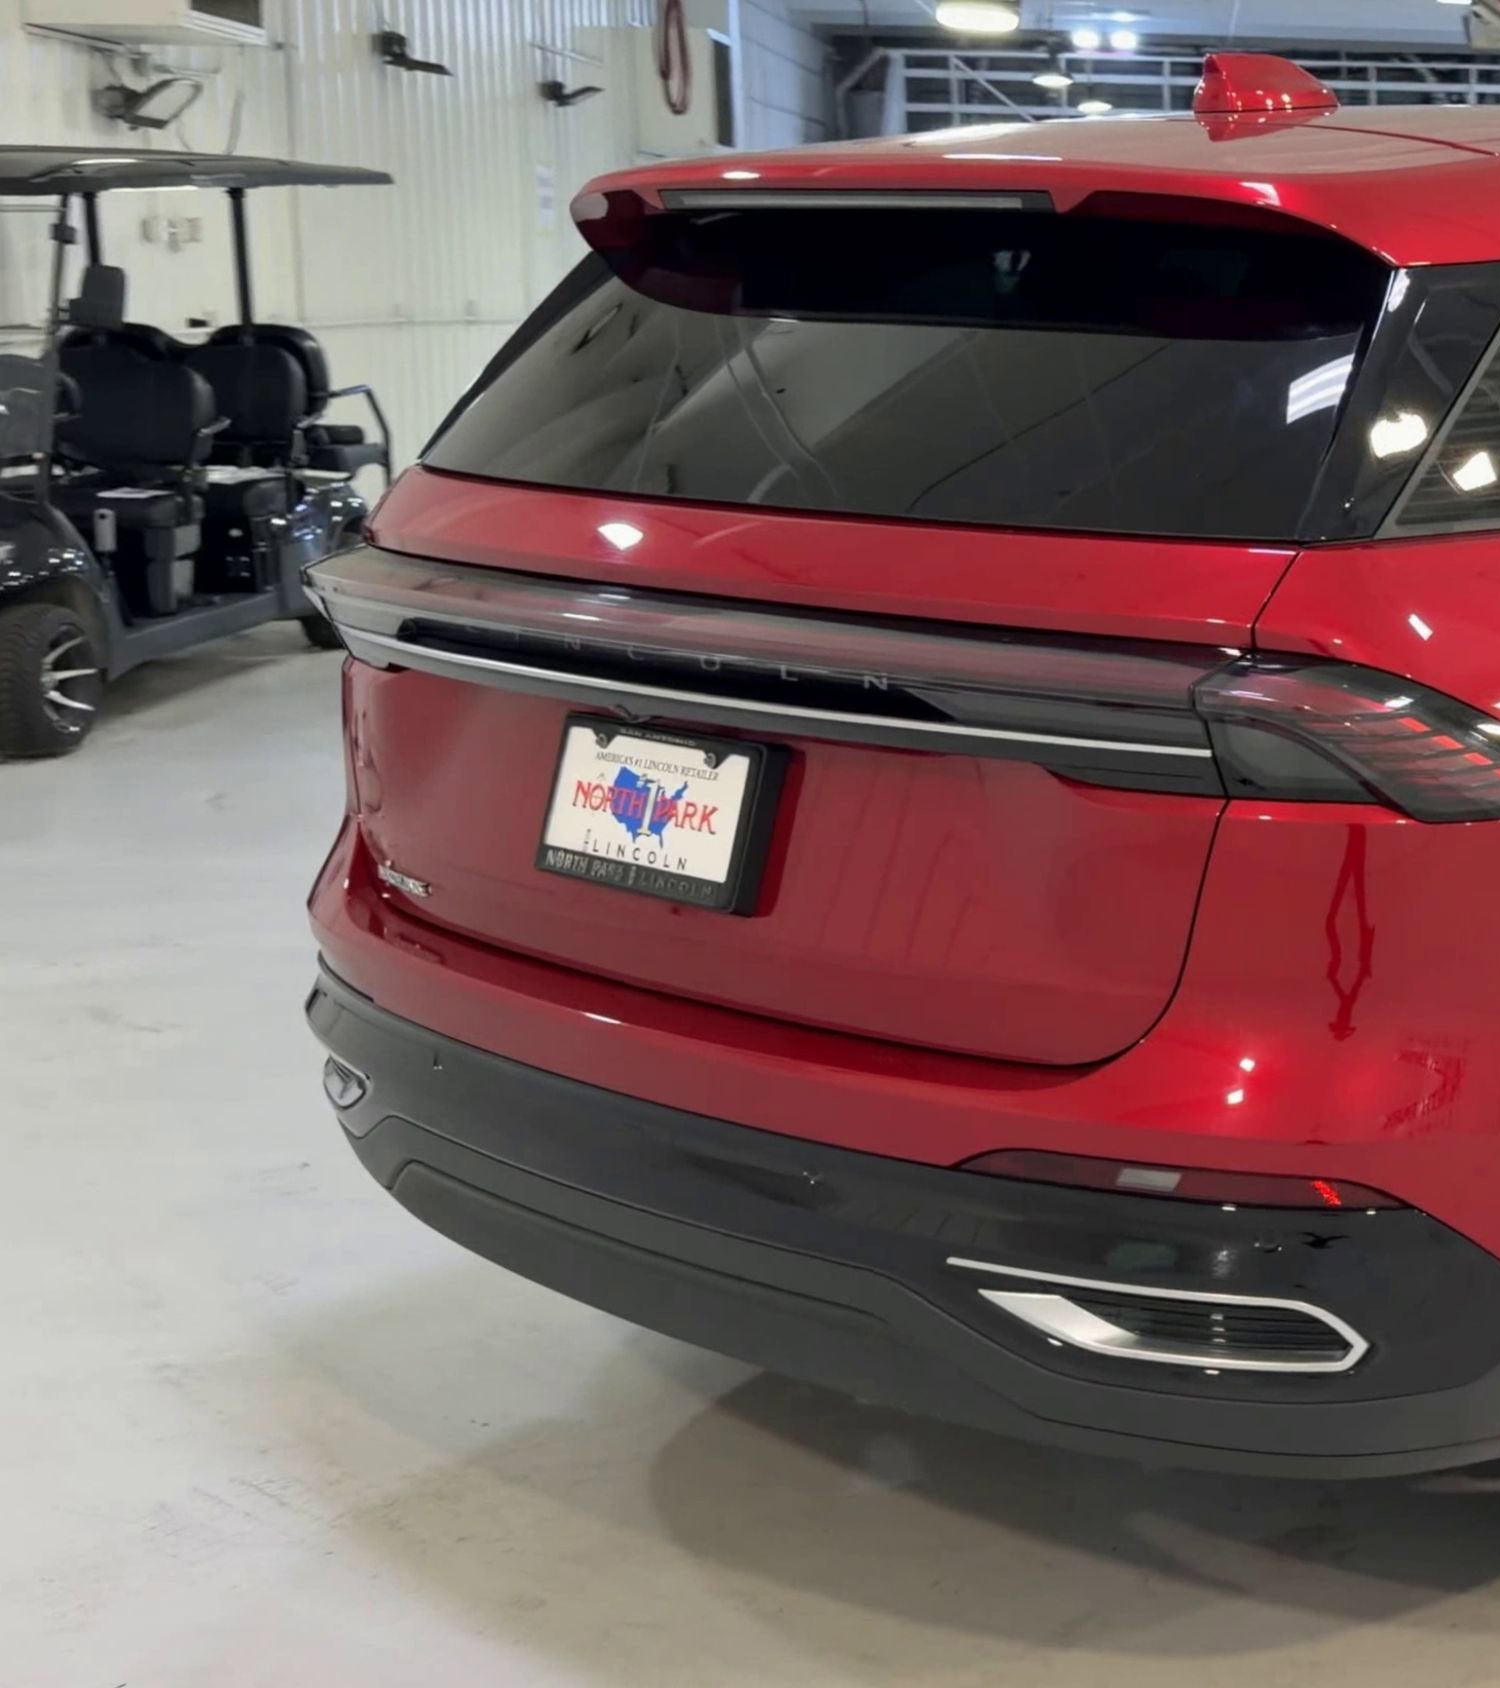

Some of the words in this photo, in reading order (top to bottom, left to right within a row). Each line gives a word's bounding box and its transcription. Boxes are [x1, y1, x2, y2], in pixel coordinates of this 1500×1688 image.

[465, 625, 888, 690] LINCOLN
[644, 757, 679, 774] LINCOLN
[680, 765, 719, 781] RETAILER
[572, 780, 647, 819] NORTH
[652, 793, 719, 835] PARK
[545, 849, 589, 874] NORTH
[639, 869, 713, 898] LINCOLN
[592, 839, 688, 871] LINCOLN
